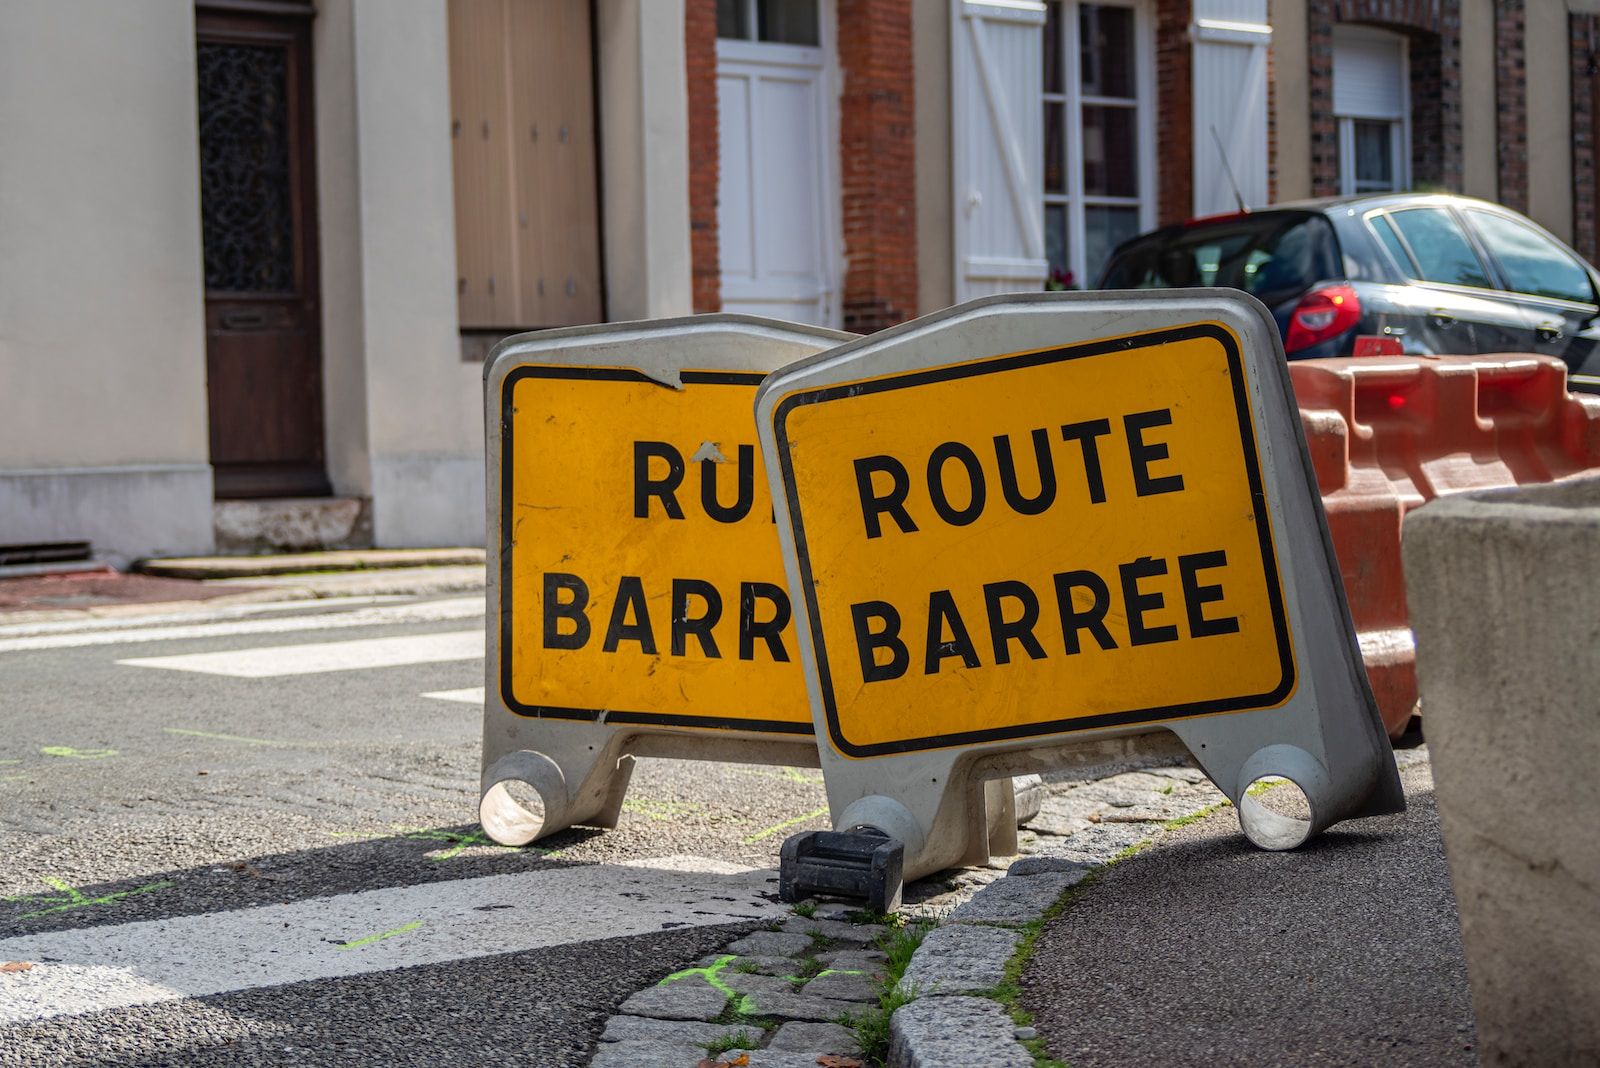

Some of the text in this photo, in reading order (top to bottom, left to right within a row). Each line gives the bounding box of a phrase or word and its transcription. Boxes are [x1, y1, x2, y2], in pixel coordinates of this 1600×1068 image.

[633, 440, 778, 524] RU
[853, 408, 1185, 539] ROUTE
[850, 549, 1240, 683] BARRÉE
